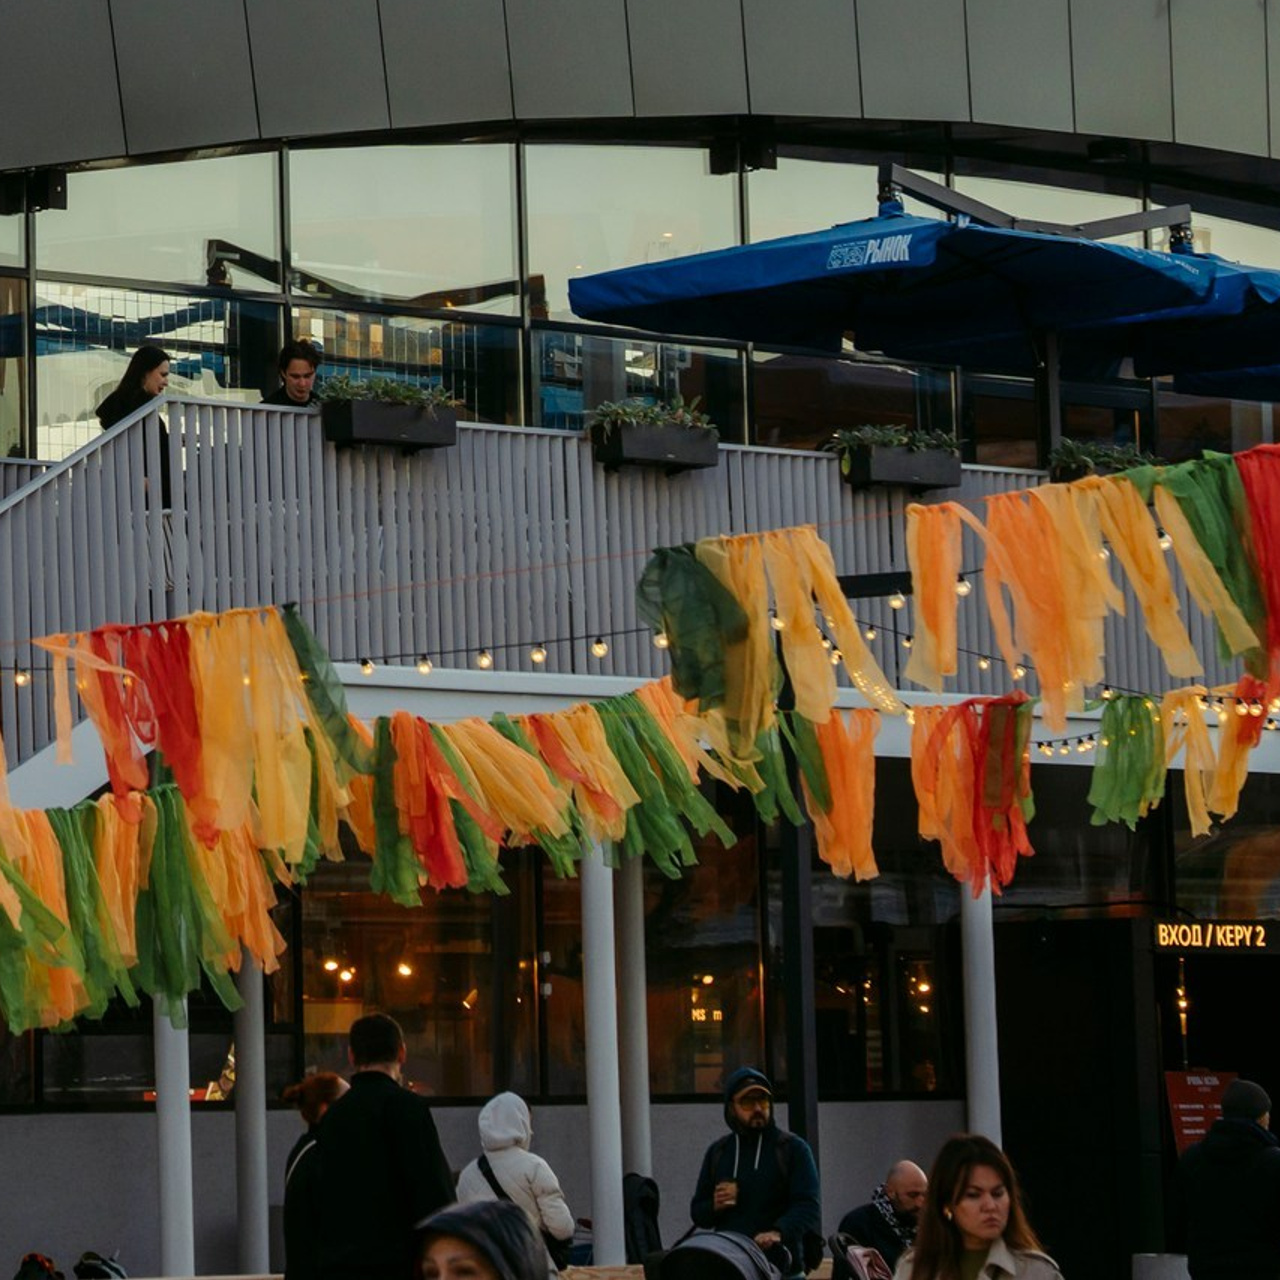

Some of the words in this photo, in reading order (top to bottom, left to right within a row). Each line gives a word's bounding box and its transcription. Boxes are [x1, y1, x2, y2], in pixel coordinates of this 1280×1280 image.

[1158, 923, 1203, 947] ВХОД
[1205, 923, 1213, 948] /
[1255, 924, 1266, 947] 2
